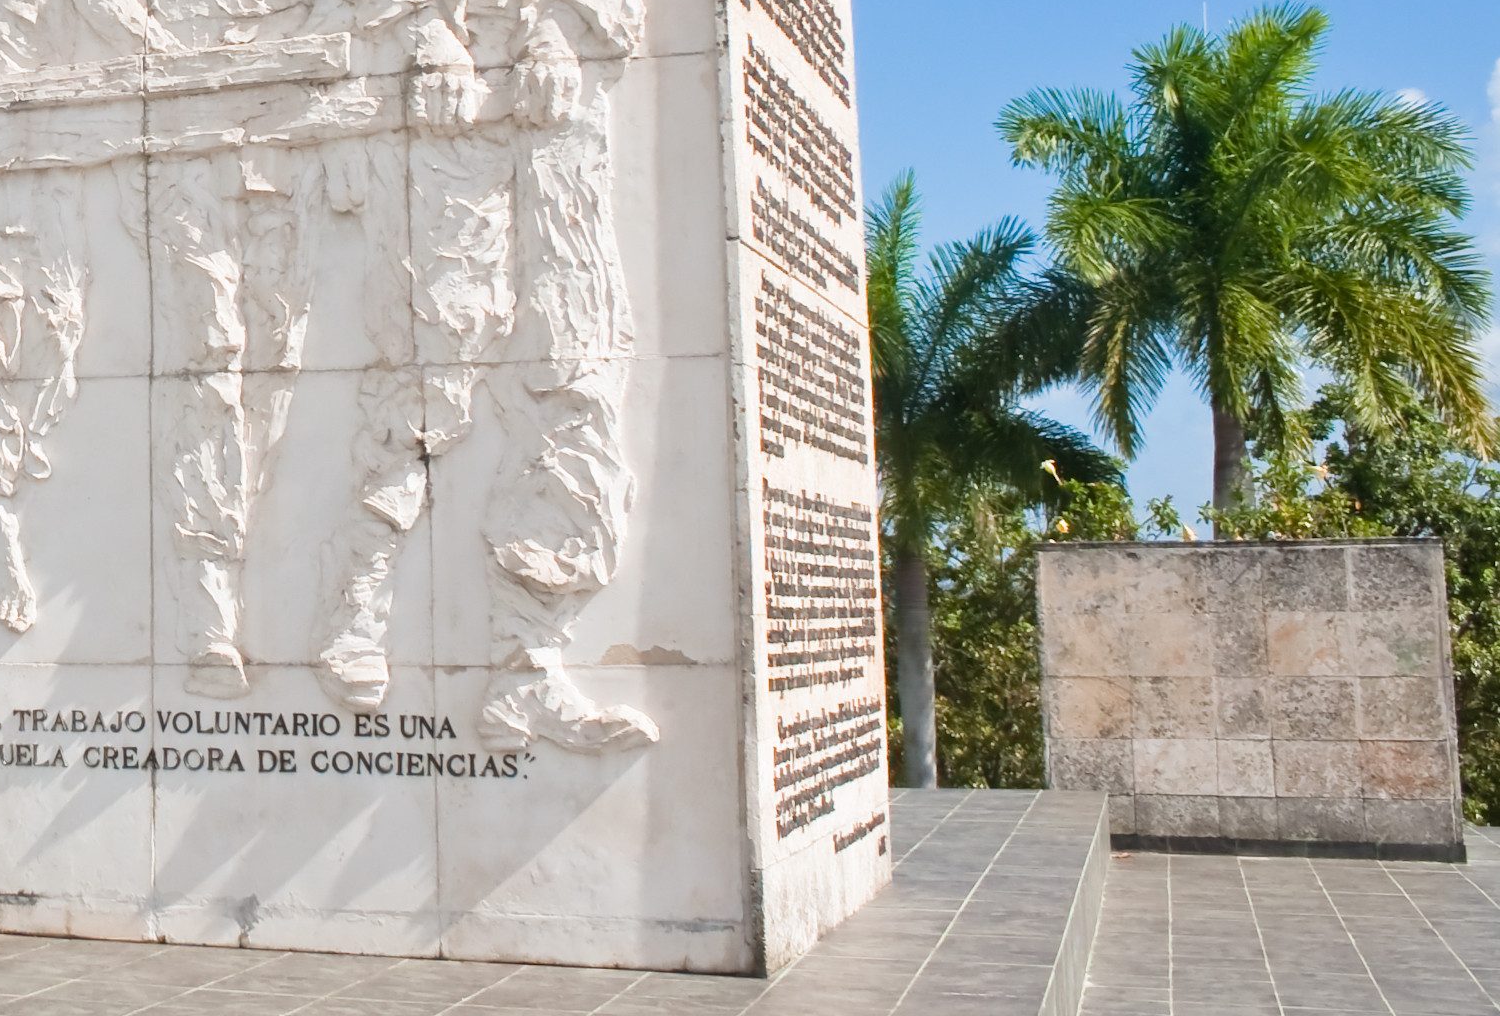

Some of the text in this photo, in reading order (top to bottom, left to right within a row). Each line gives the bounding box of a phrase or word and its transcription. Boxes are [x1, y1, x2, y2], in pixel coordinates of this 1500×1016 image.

[13, 708, 146, 734] TRABAJO
[156, 710, 341, 737] VOLUNTARIO
[354, 712, 390, 738] ES
[400, 715, 457, 740] UNA
[83, 745, 246, 773] CREADORA
[257, 749, 297, 774] DE
